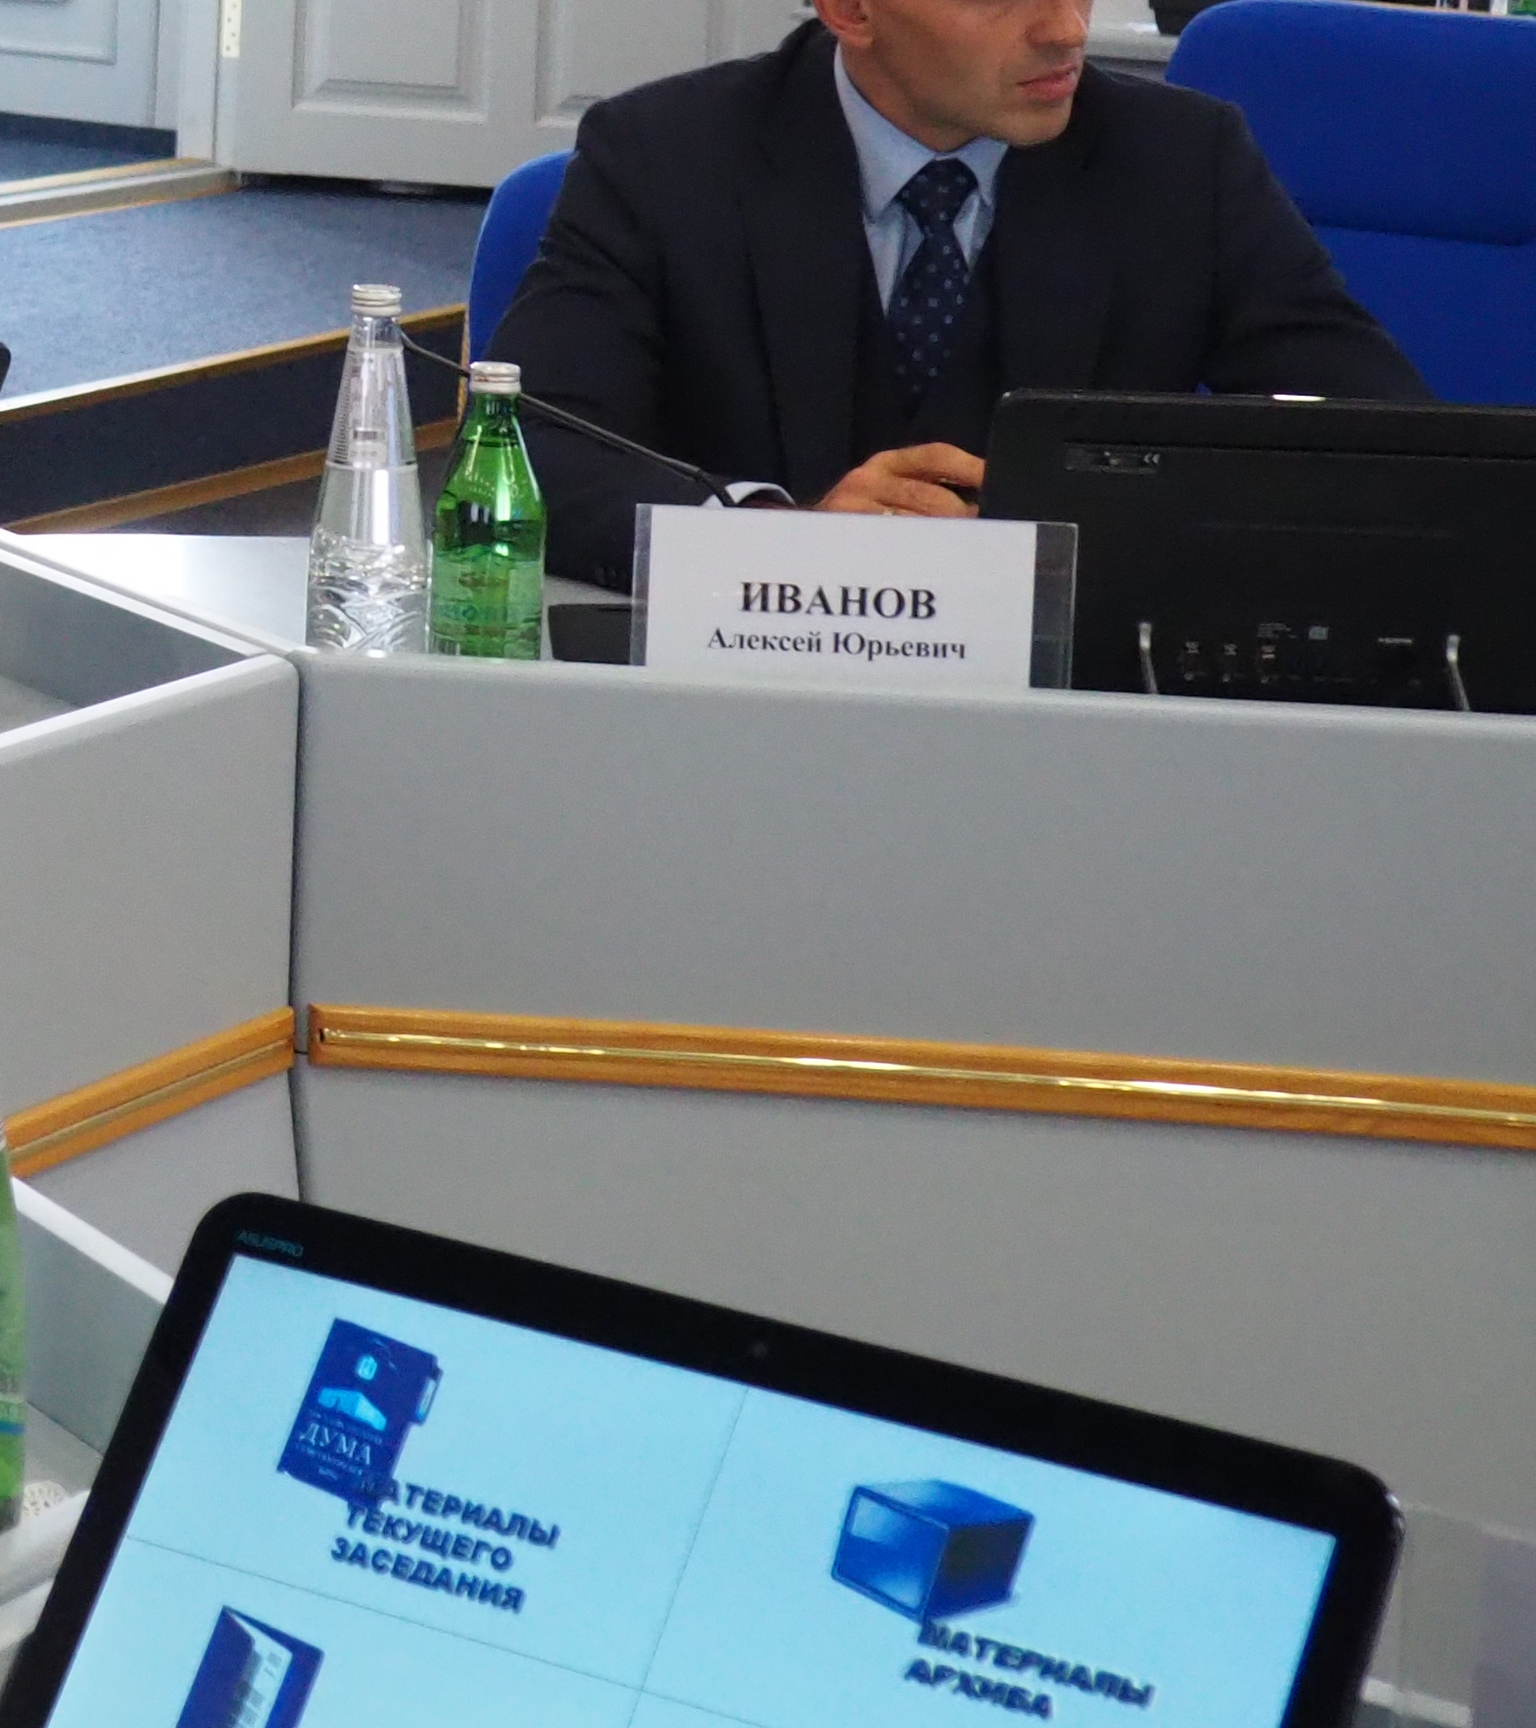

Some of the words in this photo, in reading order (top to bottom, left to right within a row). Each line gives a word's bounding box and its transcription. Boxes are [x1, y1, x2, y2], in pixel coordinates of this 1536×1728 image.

[738, 581, 938, 620] ИВАНОВ
[706, 626, 823, 654] Алексей
[832, 630, 967, 662] Юрьевич
[299, 1422, 371, 1465] ДУМА
[347, 1505, 514, 1573] ТЕКУЩЕГО
[331, 1526, 526, 1614] ЗАСЕДАНИЯ
